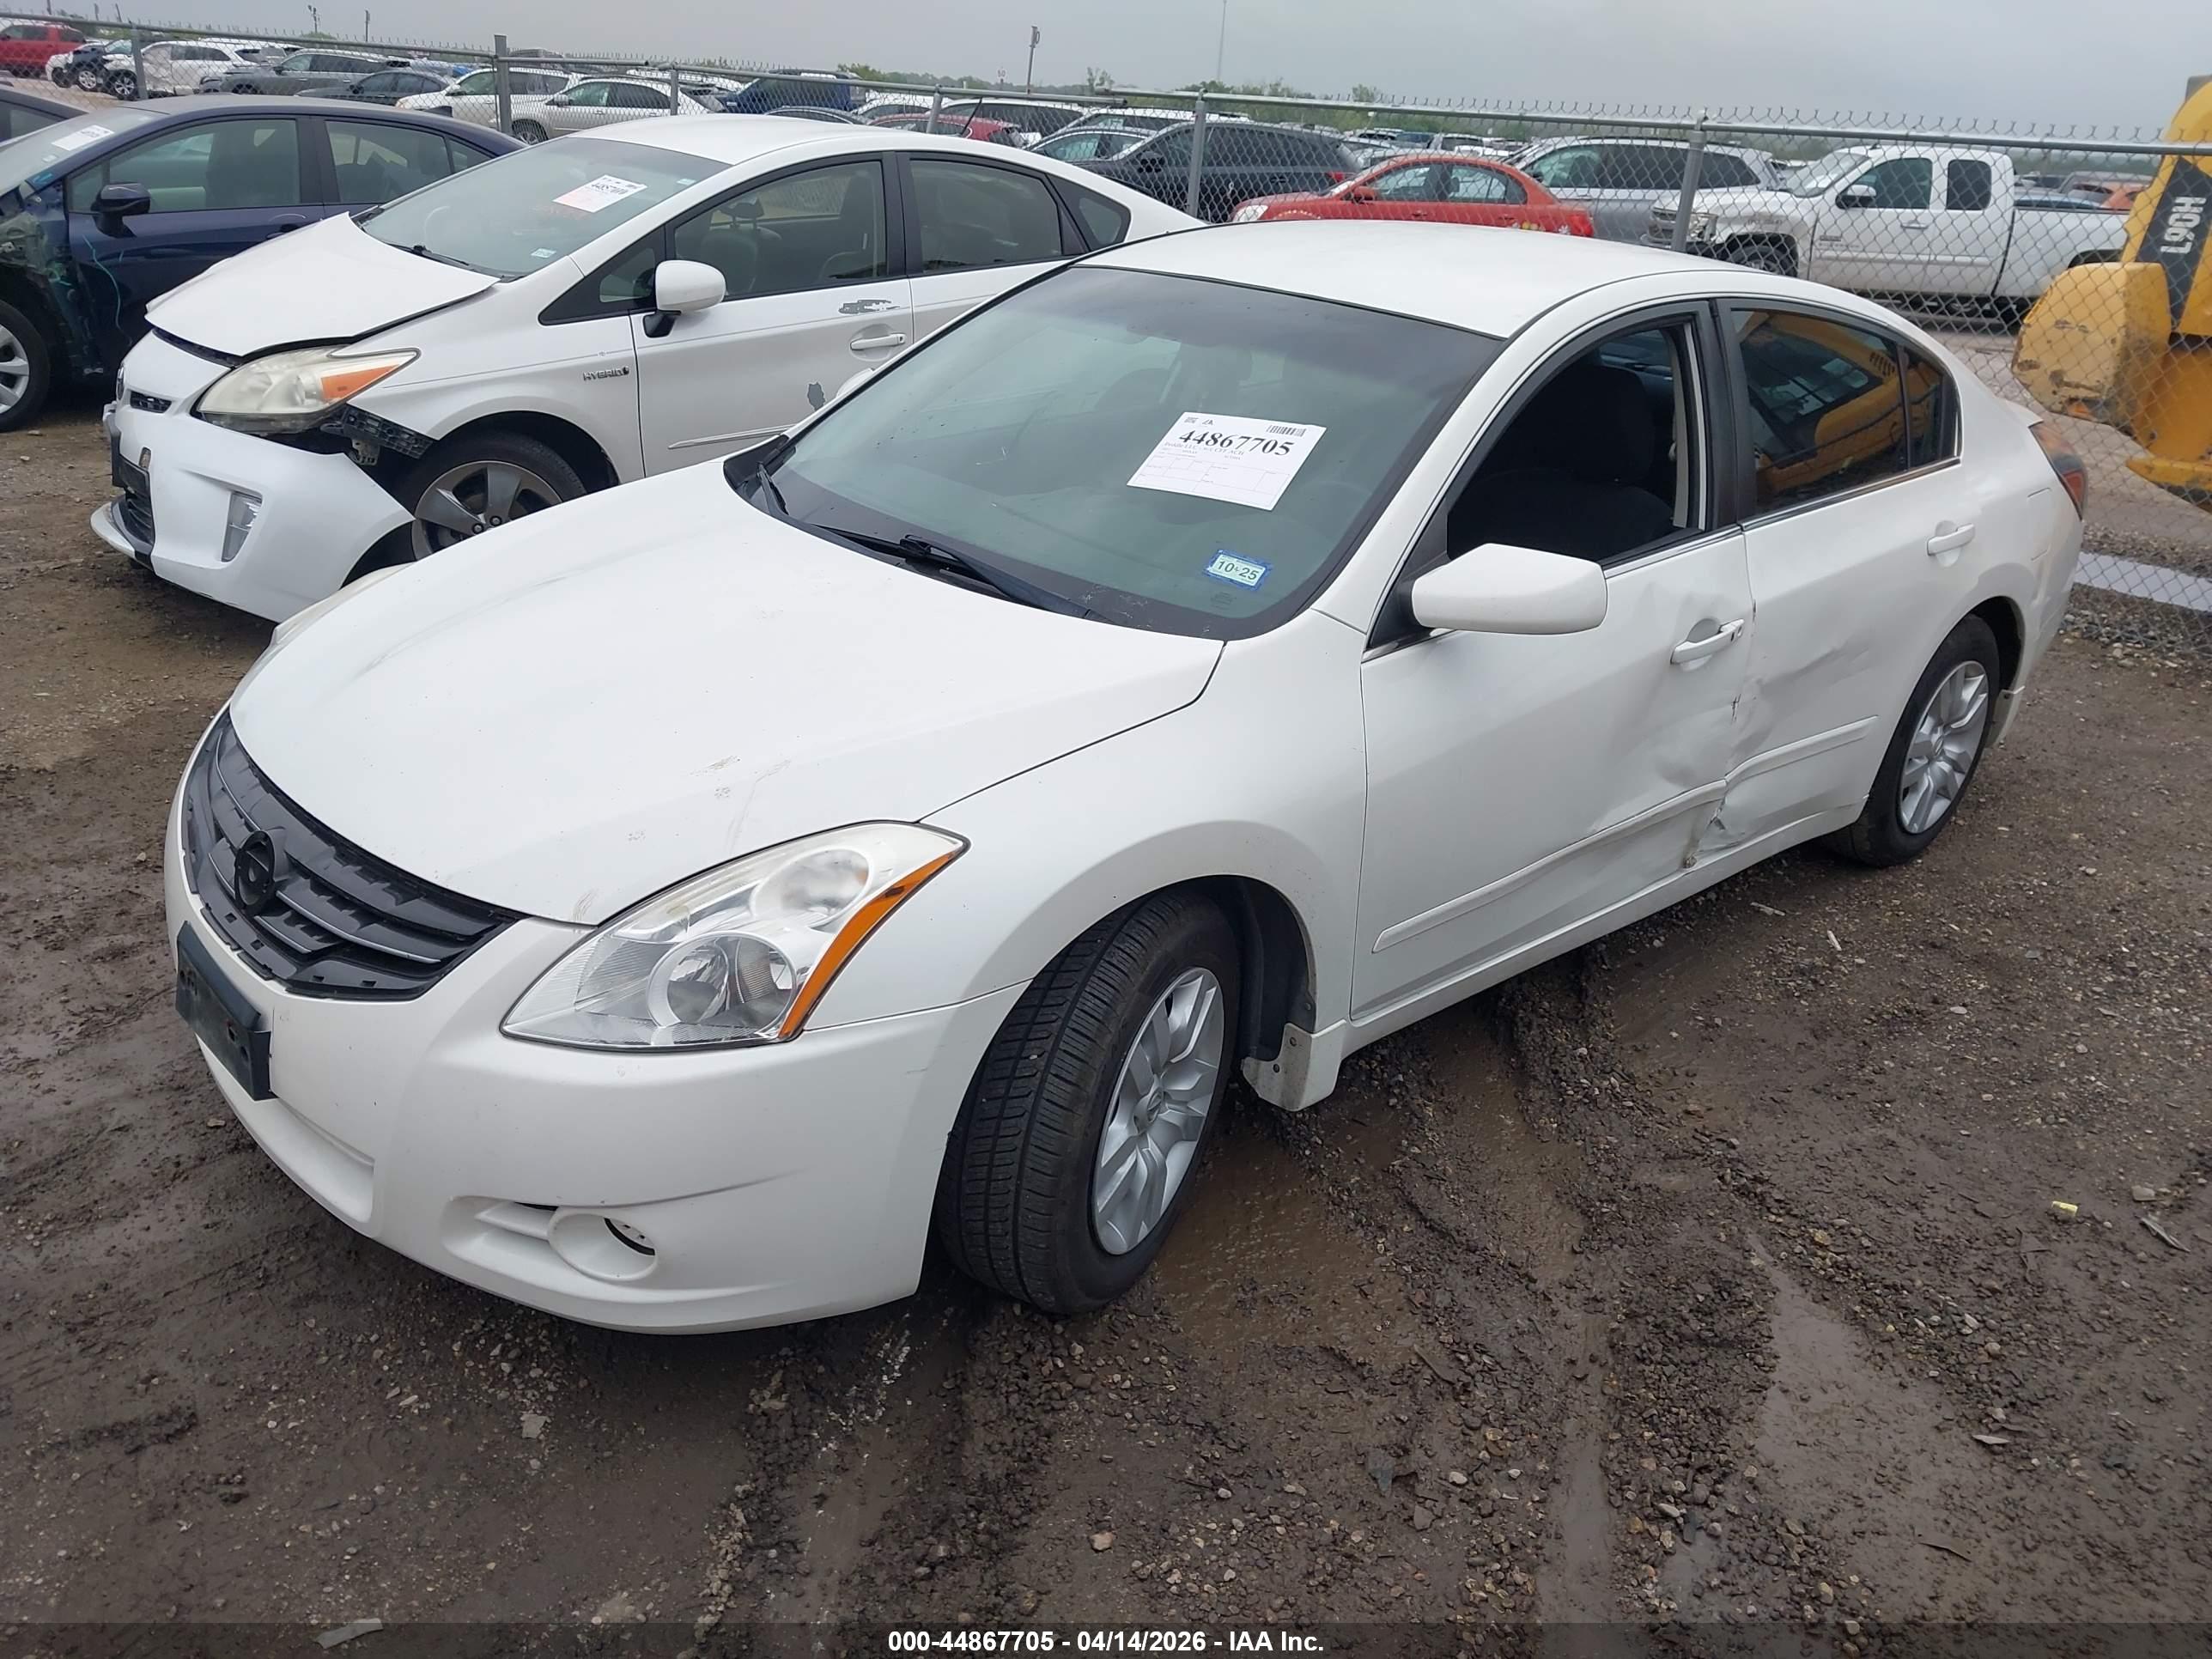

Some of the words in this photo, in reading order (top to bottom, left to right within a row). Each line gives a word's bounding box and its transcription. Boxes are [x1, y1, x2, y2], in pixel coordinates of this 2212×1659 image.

[2160, 196, 2207, 254] L90H
[583, 368, 623, 380] HYBRID
[1179, 429, 1295, 456] 44867705
[1218, 561, 1235, 573] 10
[1238, 567, 1260, 580] 25
